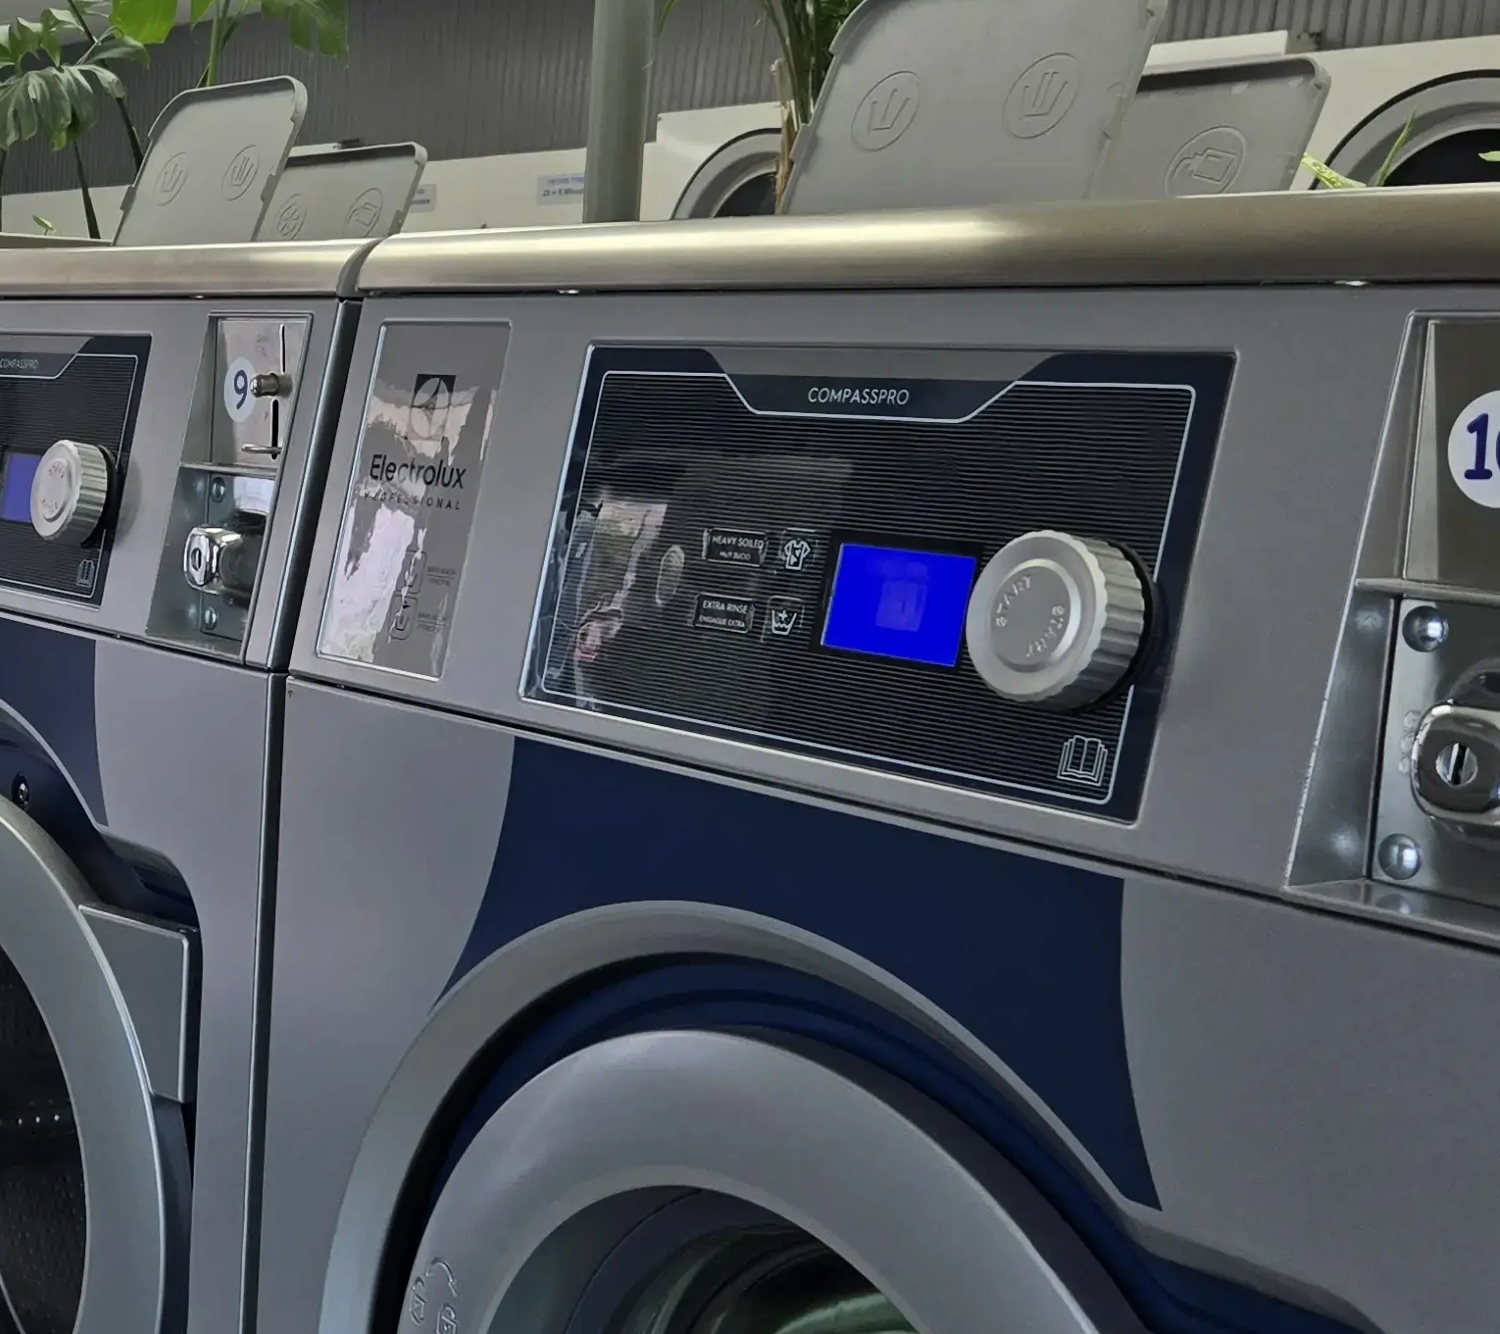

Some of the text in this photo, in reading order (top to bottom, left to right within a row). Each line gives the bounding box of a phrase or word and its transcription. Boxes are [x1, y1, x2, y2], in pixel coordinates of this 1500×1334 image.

[233, 369, 249, 410] 9
[808, 387, 910, 405] COMPASSPRO
[1464, 413, 1500, 479] 1
[369, 454, 467, 489] Electrolux
[711, 535, 764, 549] HEAVY SOILED
[702, 600, 748, 615] EXTRA RINSE
[995, 575, 1033, 627] START
